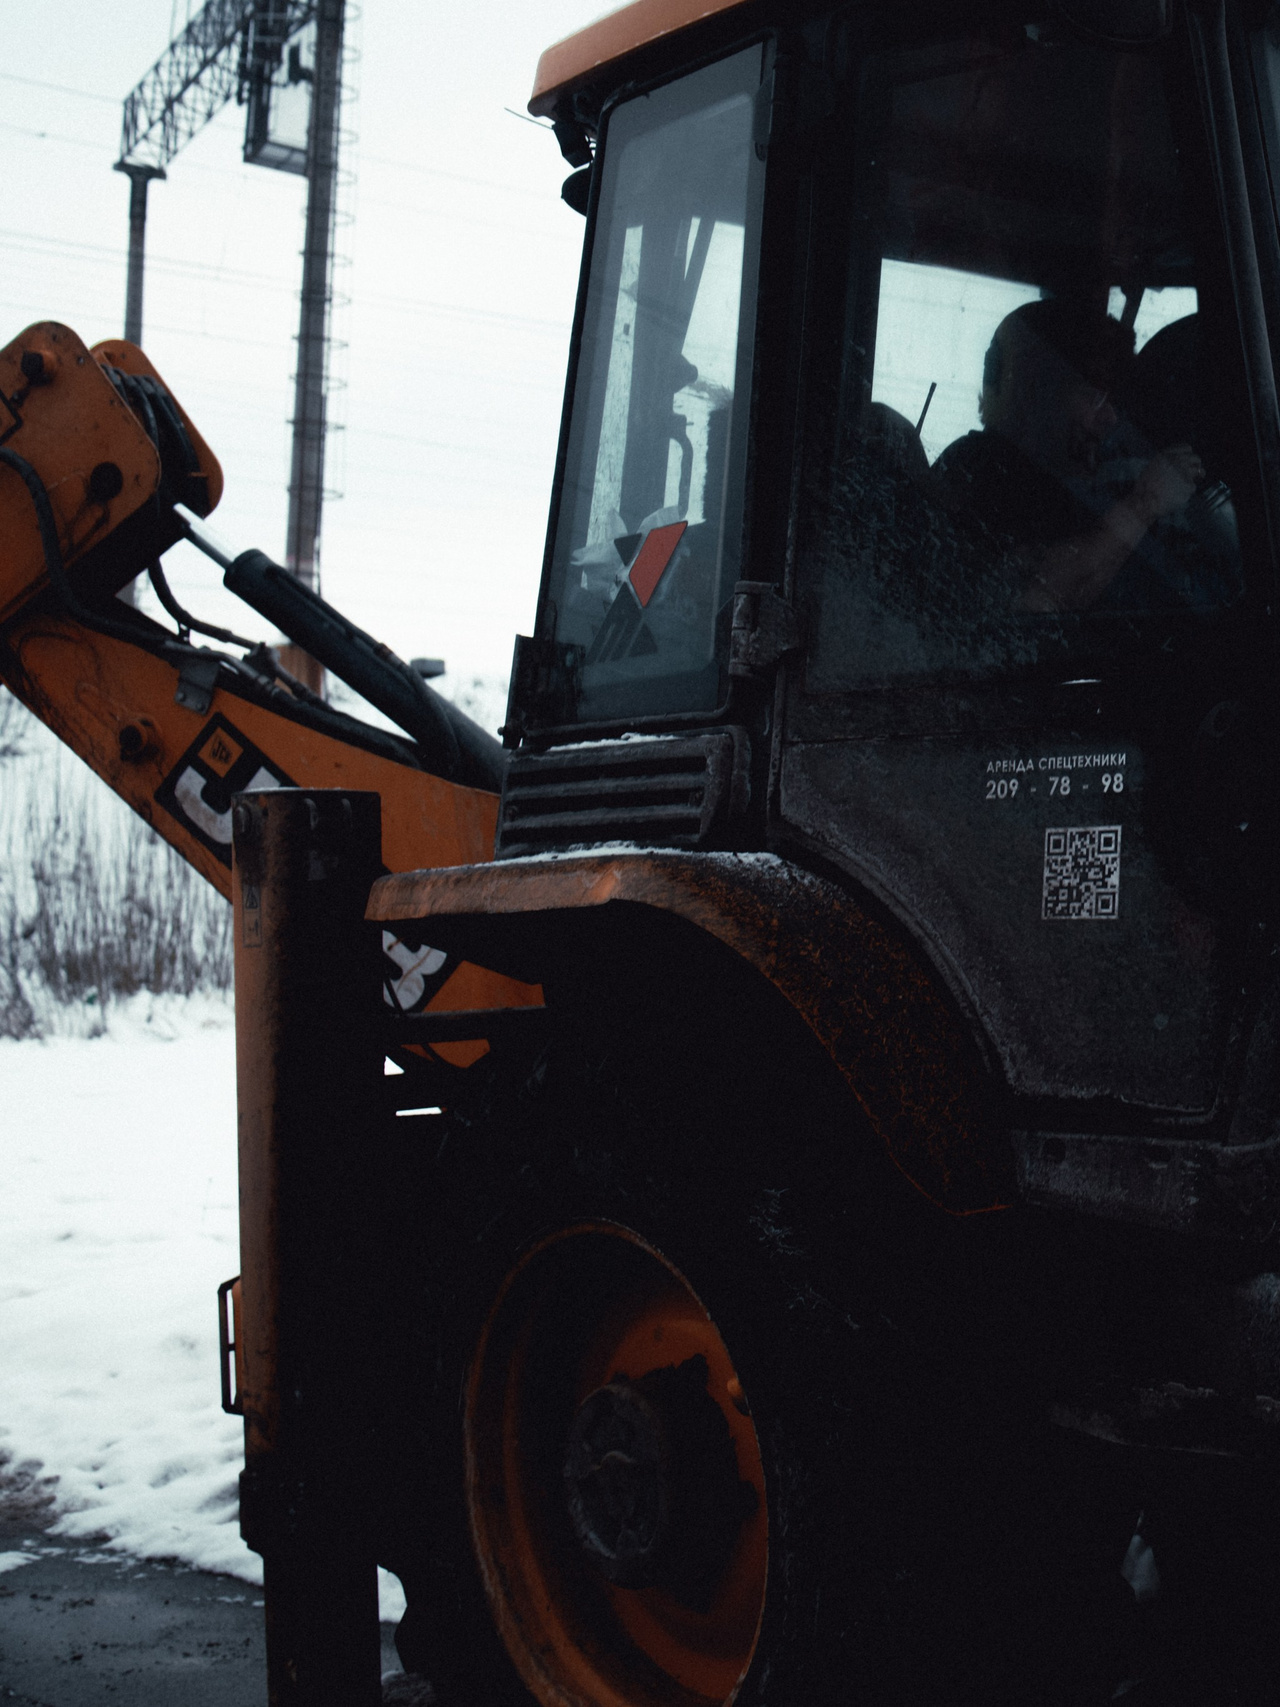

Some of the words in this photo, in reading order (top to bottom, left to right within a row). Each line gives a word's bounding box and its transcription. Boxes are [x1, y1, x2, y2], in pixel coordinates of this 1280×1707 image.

[986, 758, 1034, 773] АРЕНДА
[1038, 753, 1126, 770] СПЕЦТЕХНИКИ
[985, 778, 1019, 799] 209
[1049, 775, 1071, 795] 78
[1101, 772, 1124, 793] 98
